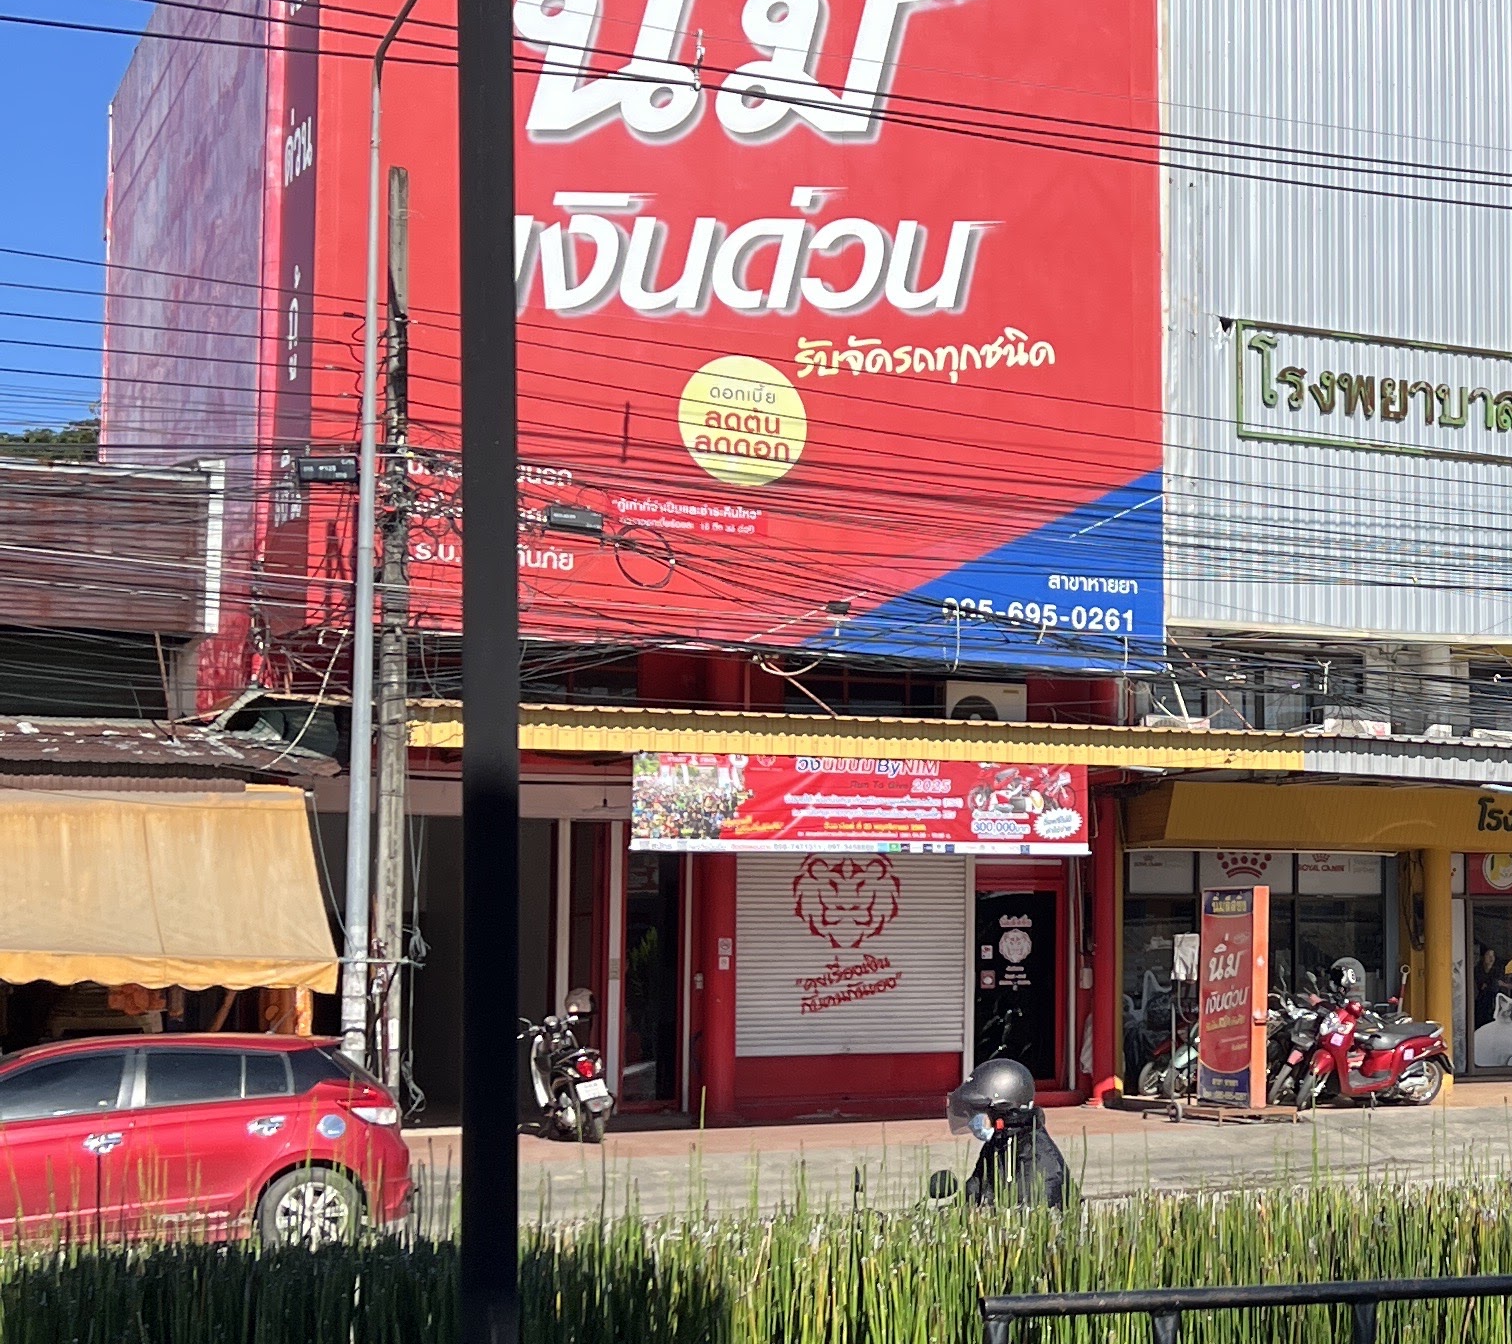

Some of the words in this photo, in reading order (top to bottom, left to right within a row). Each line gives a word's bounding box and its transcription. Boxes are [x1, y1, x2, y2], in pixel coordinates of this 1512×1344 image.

[285, 107, 313, 186] ด่วน
[795, 327, 1056, 383] รับจัดรถทุกชนิด
[710, 383, 776, 404] ดอกเบี้ย
[705, 407, 780, 435] ลดต้น
[694, 434, 790, 462] ลดดอก
[1048, 574, 1139, 595] สาขาหายยา
[1208, 932, 1247, 982] นิ่ม
[1205, 985, 1250, 1015] เงินด่วน
